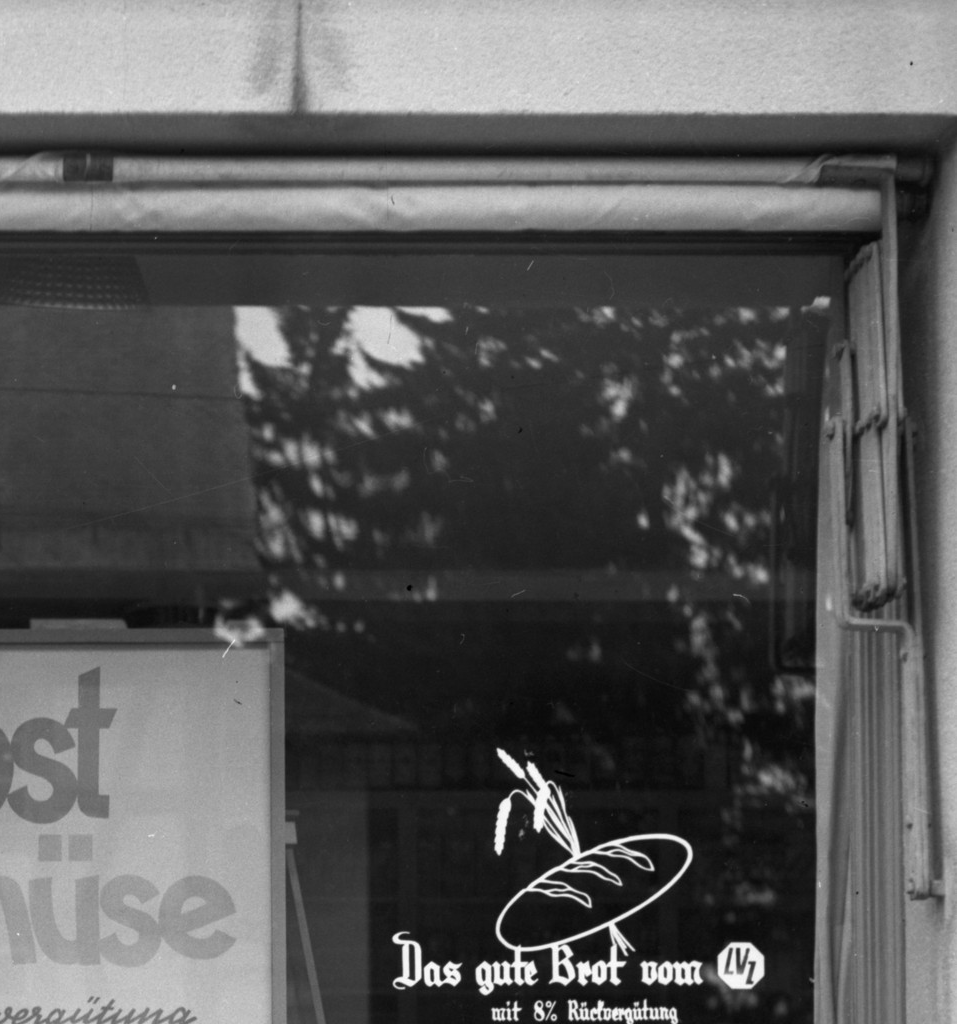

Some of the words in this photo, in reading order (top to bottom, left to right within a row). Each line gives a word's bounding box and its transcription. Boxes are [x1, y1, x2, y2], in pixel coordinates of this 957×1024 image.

[392, 931, 463, 990] Das
[475, 945, 539, 995] gute
[548, 943, 627, 987] Brot
[640, 960, 704, 985] vom
[491, 1000, 523, 1022] mit
[533, 1000, 558, 1022] 8%
